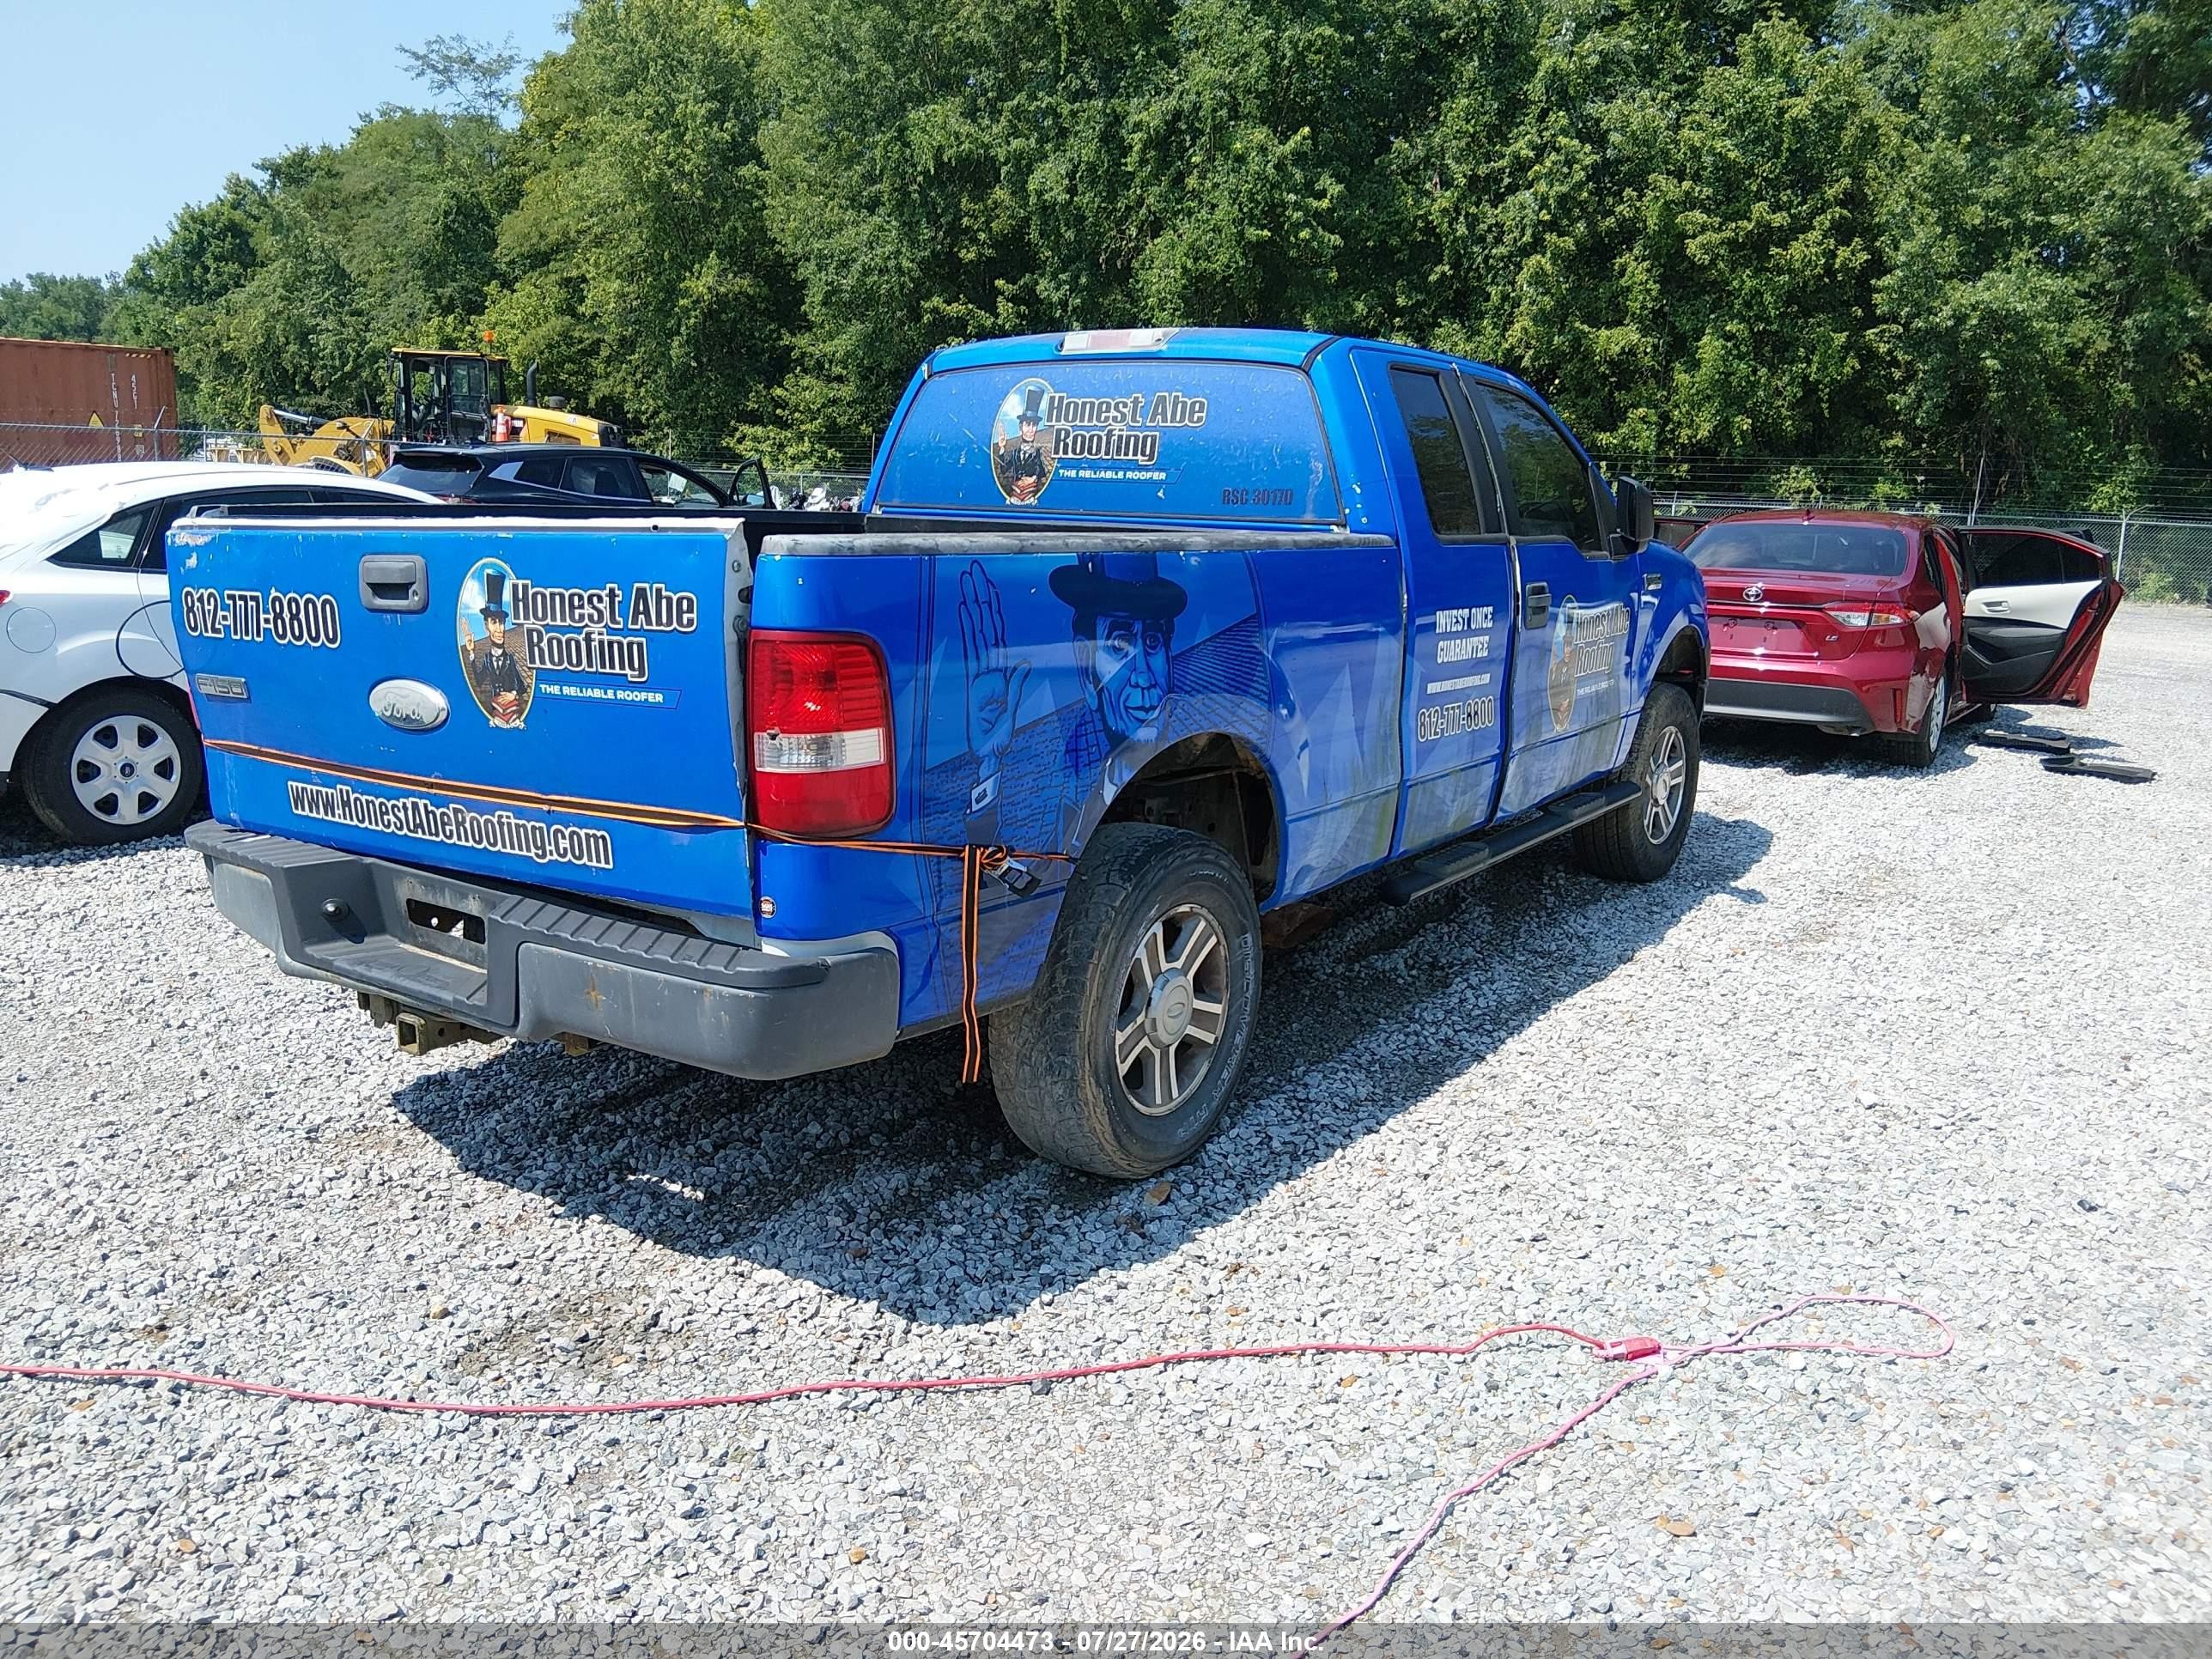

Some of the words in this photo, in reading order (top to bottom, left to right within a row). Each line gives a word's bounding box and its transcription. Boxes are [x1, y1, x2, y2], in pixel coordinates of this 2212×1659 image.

[111, 373, 119, 408] TCNU
[1045, 392, 1146, 426] Honest
[1146, 392, 1207, 427] Abe
[1052, 427, 1159, 465] Roofing
[1059, 469, 1077, 478] THE
[1078, 470, 1124, 480] RELIABLE
[1126, 471, 1167, 481] ROOFER
[1222, 489, 1249, 505] RSC
[183, 587, 342, 647] 812-777-8800
[510, 580, 623, 629] Honest
[629, 583, 697, 632] Abe
[1435, 609, 1470, 634] INVEST
[1471, 606, 1494, 631] ONCE
[1573, 610, 1613, 645] Honest
[1610, 603, 1631, 636] Abe
[524, 625, 648, 681] Roofing
[1437, 635, 1490, 664] GUARANTEE
[1575, 641, 1615, 678] Roofing
[197, 676, 246, 696] F-150
[539, 684, 561, 696] THE
[562, 686, 616, 700] RELIABLE
[617, 690, 664, 703] ROOFER
[383, 692, 424, 720] Ford
[1418, 696, 1495, 742] 812-777-8800
[288, 781, 613, 869] www.HonestAbeRoofing.com
